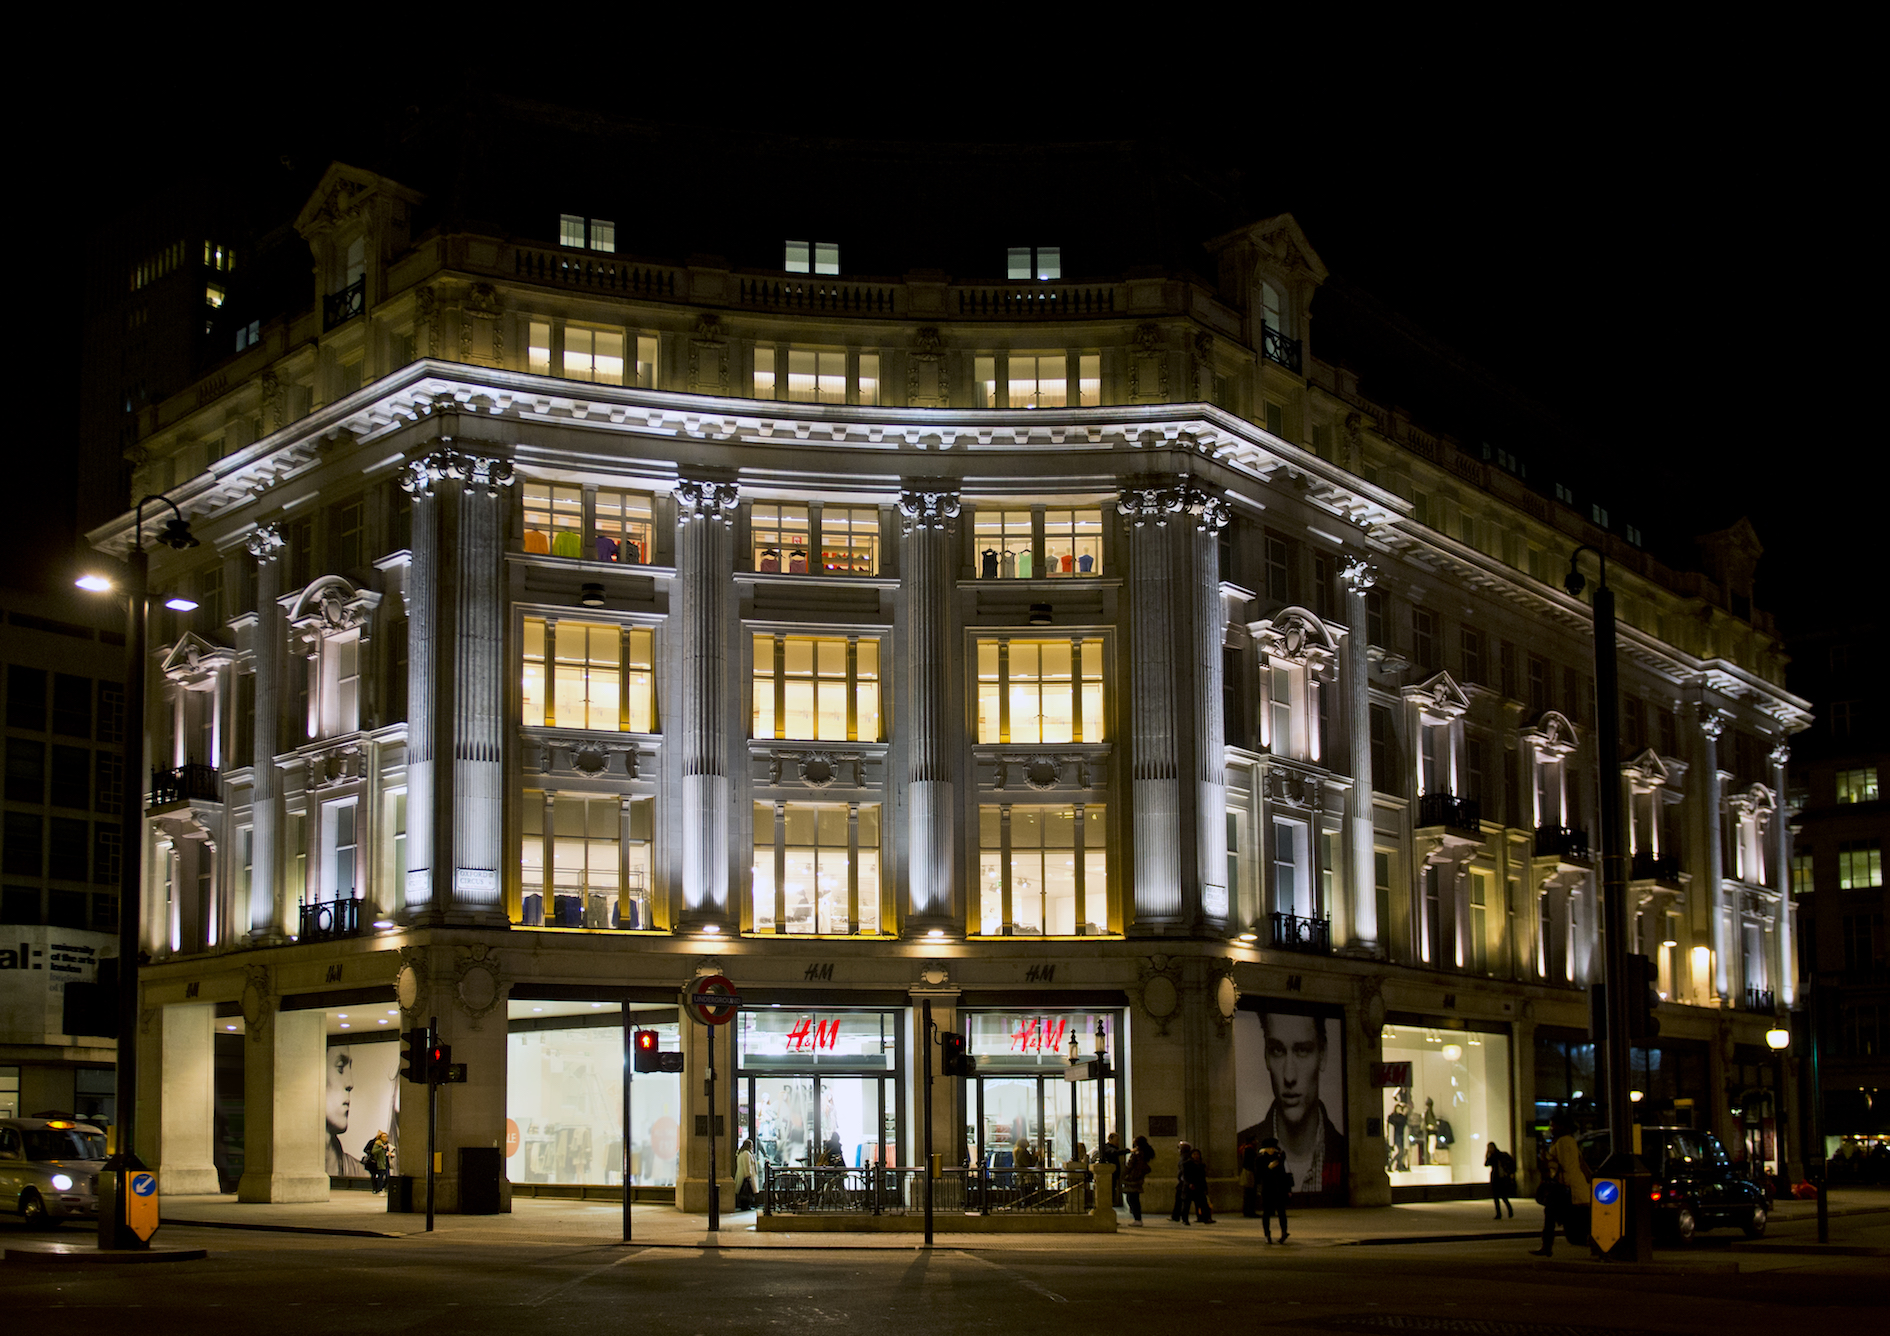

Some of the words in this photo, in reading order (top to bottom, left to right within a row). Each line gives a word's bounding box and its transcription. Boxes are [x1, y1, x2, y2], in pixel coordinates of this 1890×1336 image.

[50, 962, 82, 974] london
[803, 963, 834, 981] H&M
[1026, 964, 1056, 983] H&M
[693, 995, 742, 1004] UNDERGROUND
[785, 1018, 841, 1052] H&M
[1010, 1018, 1066, 1053] H&M
[506, 1133, 517, 1143] LE
